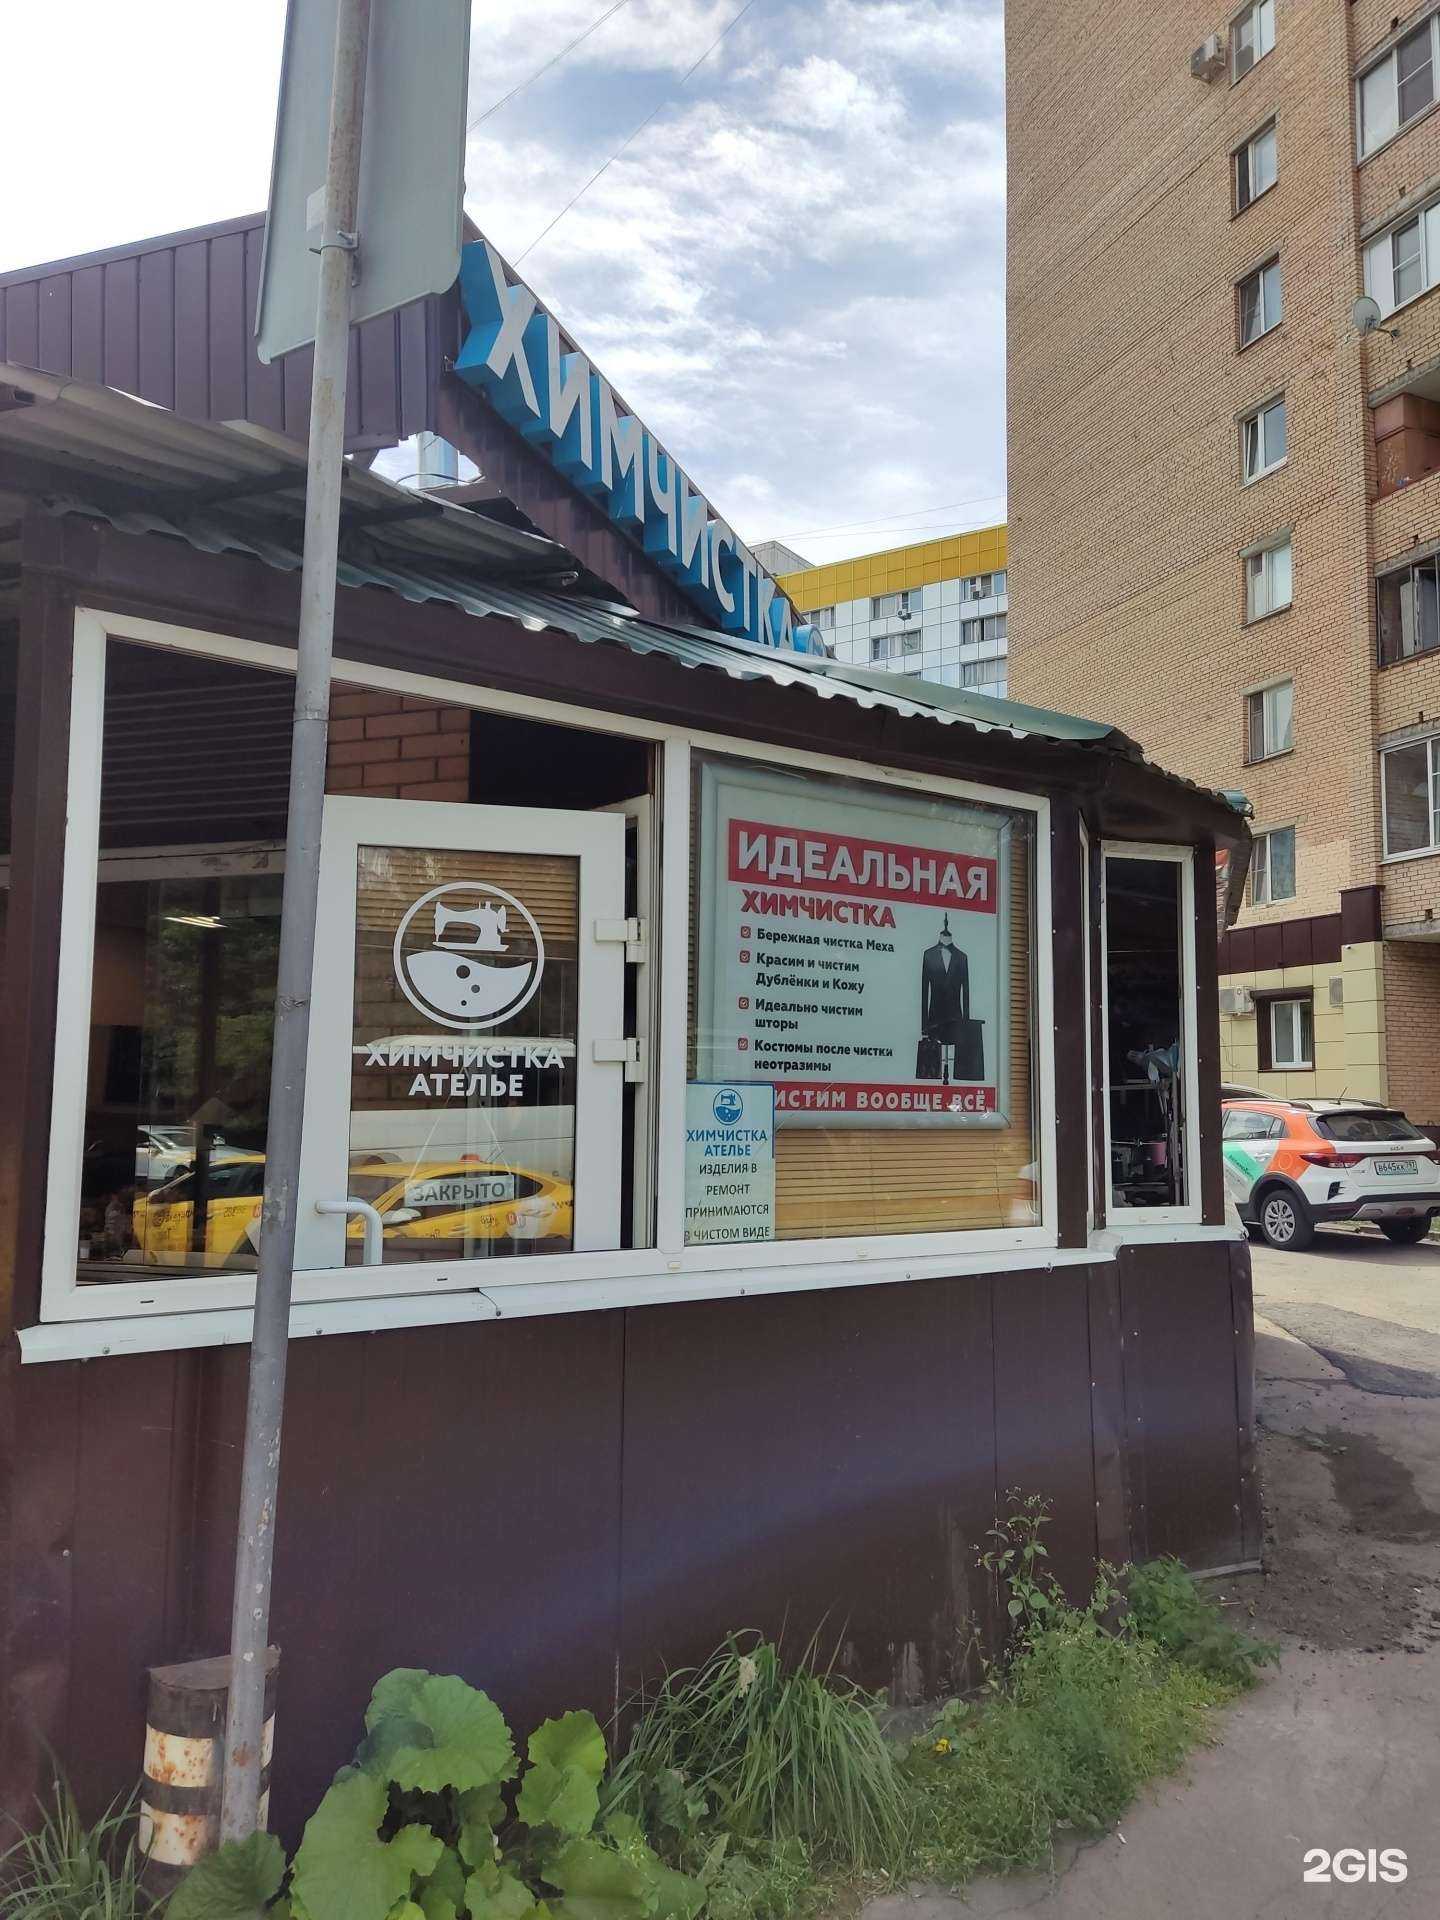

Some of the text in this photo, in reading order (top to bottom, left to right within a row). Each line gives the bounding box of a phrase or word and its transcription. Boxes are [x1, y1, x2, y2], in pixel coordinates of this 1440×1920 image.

[456, 239, 795, 651] ХИМЧИСТКА
[737, 830, 989, 901] ИДЕАЛЬНАЯ
[740, 889, 897, 929] ХИМЧИСТКА
[757, 928, 895, 953] Бережная чистка Меха
[756, 952, 860, 972] Красим и чистим
[755, 972, 865, 993] Дублёнки и Кожу
[755, 999, 863, 1016] Идеально чистим
[755, 1018, 798, 1031] шторы
[365, 1043, 566, 1069] ХИМЧИСТКА
[754, 1040, 893, 1056] Костюмы после чистки
[754, 1060, 831, 1073] неотразимы
[408, 1073, 524, 1097] АТЕЛЬЕ
[775, 1089, 986, 1111] ИСТИМ ВООБЩЕ ВСЁ
[686, 1129, 768, 1142] ХИМЧИСТКА
[704, 1144, 751, 1157] АТЕЛЬЕ
[699, 1163, 758, 1176] ИЗДЕЛИЯ В
[414, 1182, 506, 1202] ЗАКРЫТО
[706, 1184, 750, 1196] РЕМОНТ
[685, 1204, 769, 1219] ПРИНИМАЮТСЯ
[694, 1228, 740, 1241] ЧИСТОМ
[742, 1226, 770, 1239] ВИДЕ
